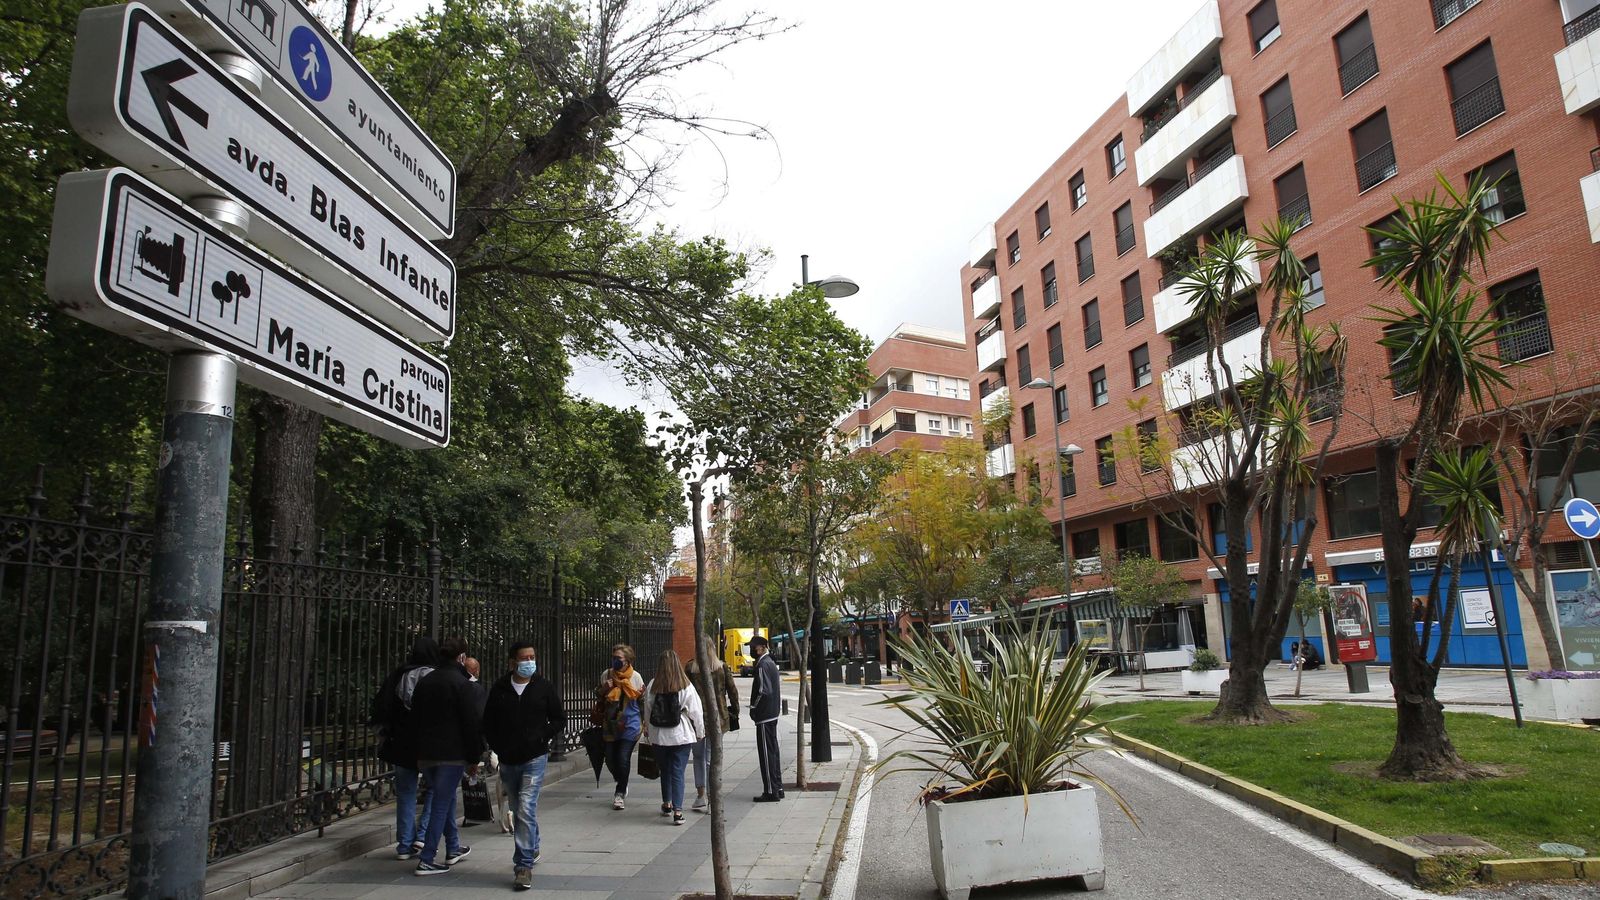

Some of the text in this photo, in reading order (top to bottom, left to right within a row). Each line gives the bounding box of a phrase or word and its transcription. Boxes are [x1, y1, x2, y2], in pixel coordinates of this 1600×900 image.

[347, 98, 445, 203] ayuntamiento
[226, 137, 449, 311] avda. Blas Infante
[267, 317, 443, 432] María Cristina
[400, 357, 444, 393] parque
[221, 405, 233, 418] 12
[1409, 547, 1422, 557] 82
